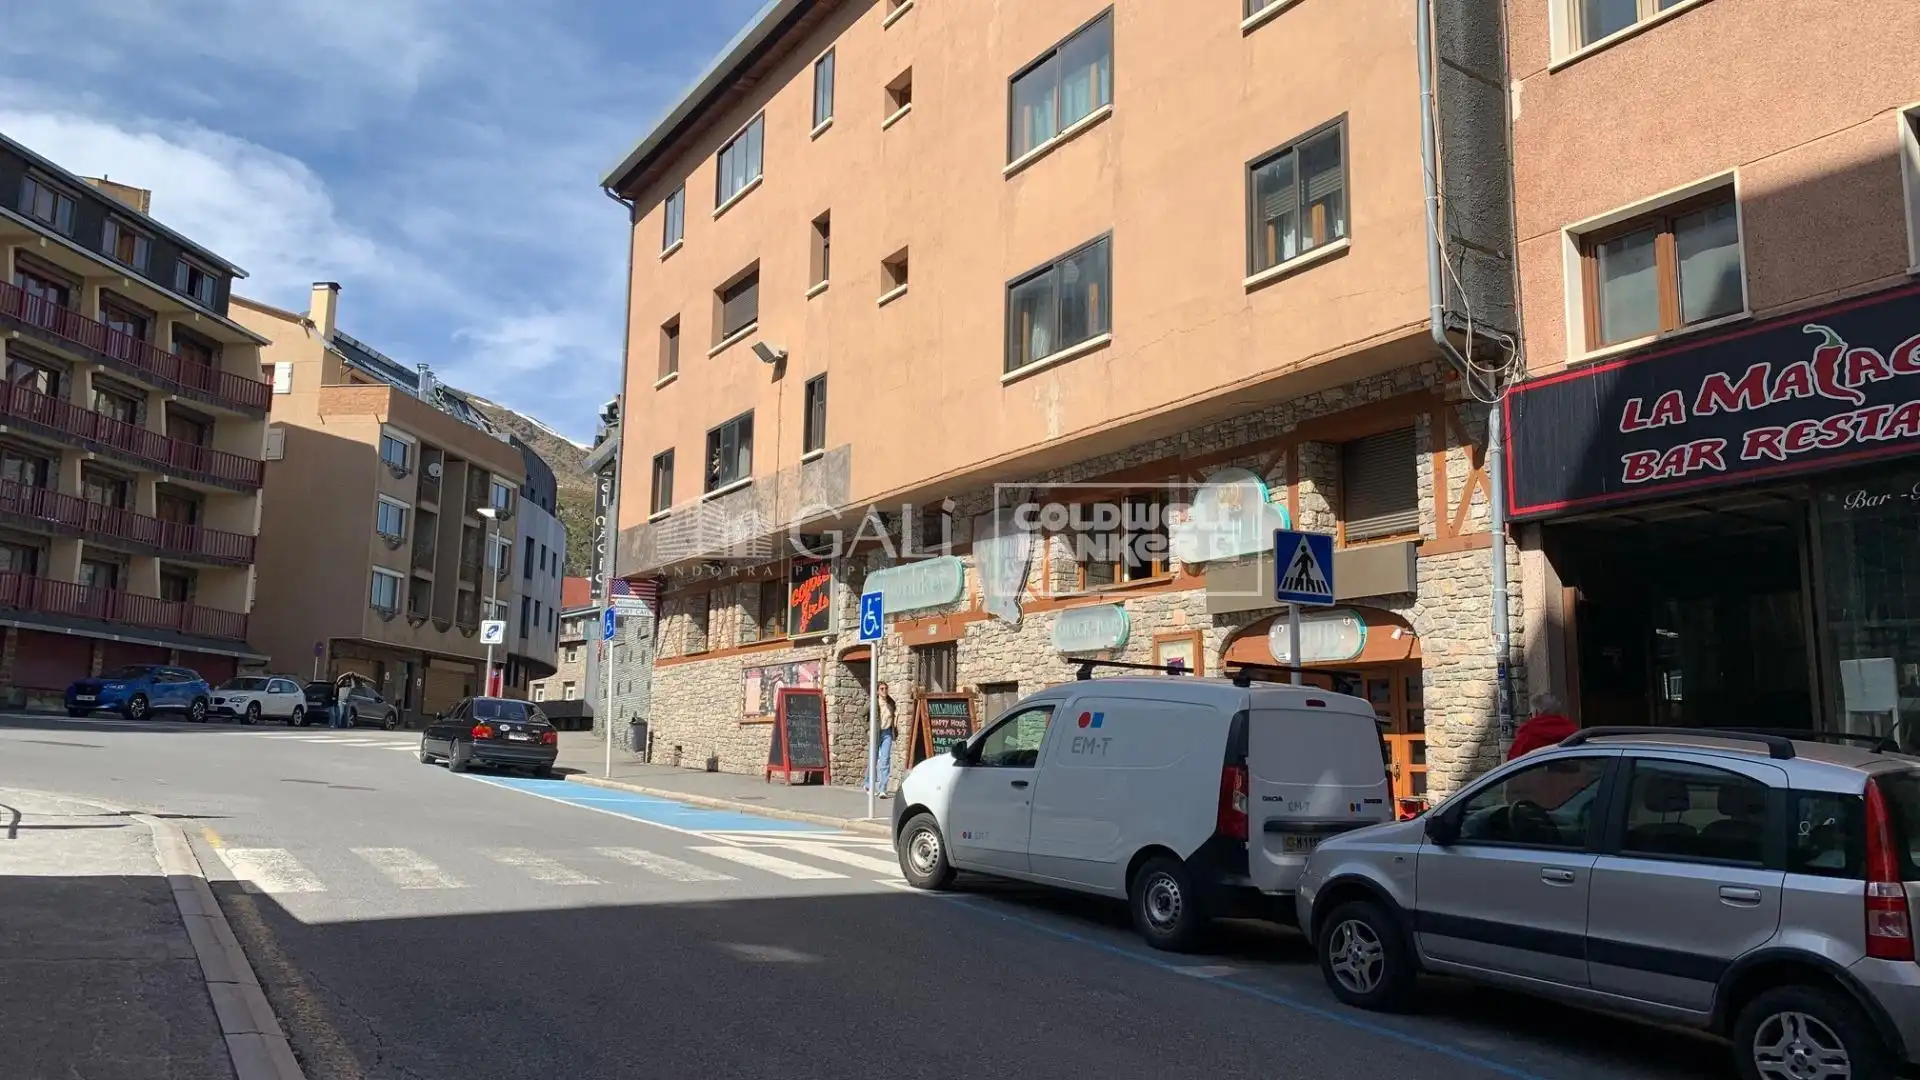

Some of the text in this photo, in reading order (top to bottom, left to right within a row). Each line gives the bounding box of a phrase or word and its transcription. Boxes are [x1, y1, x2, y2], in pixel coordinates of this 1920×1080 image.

[1620, 390, 1686, 433] LA
[1621, 438, 1727, 483] BAR
[1844, 490, 1892, 511] Bar
[931, 719, 949, 728] HAPPY
